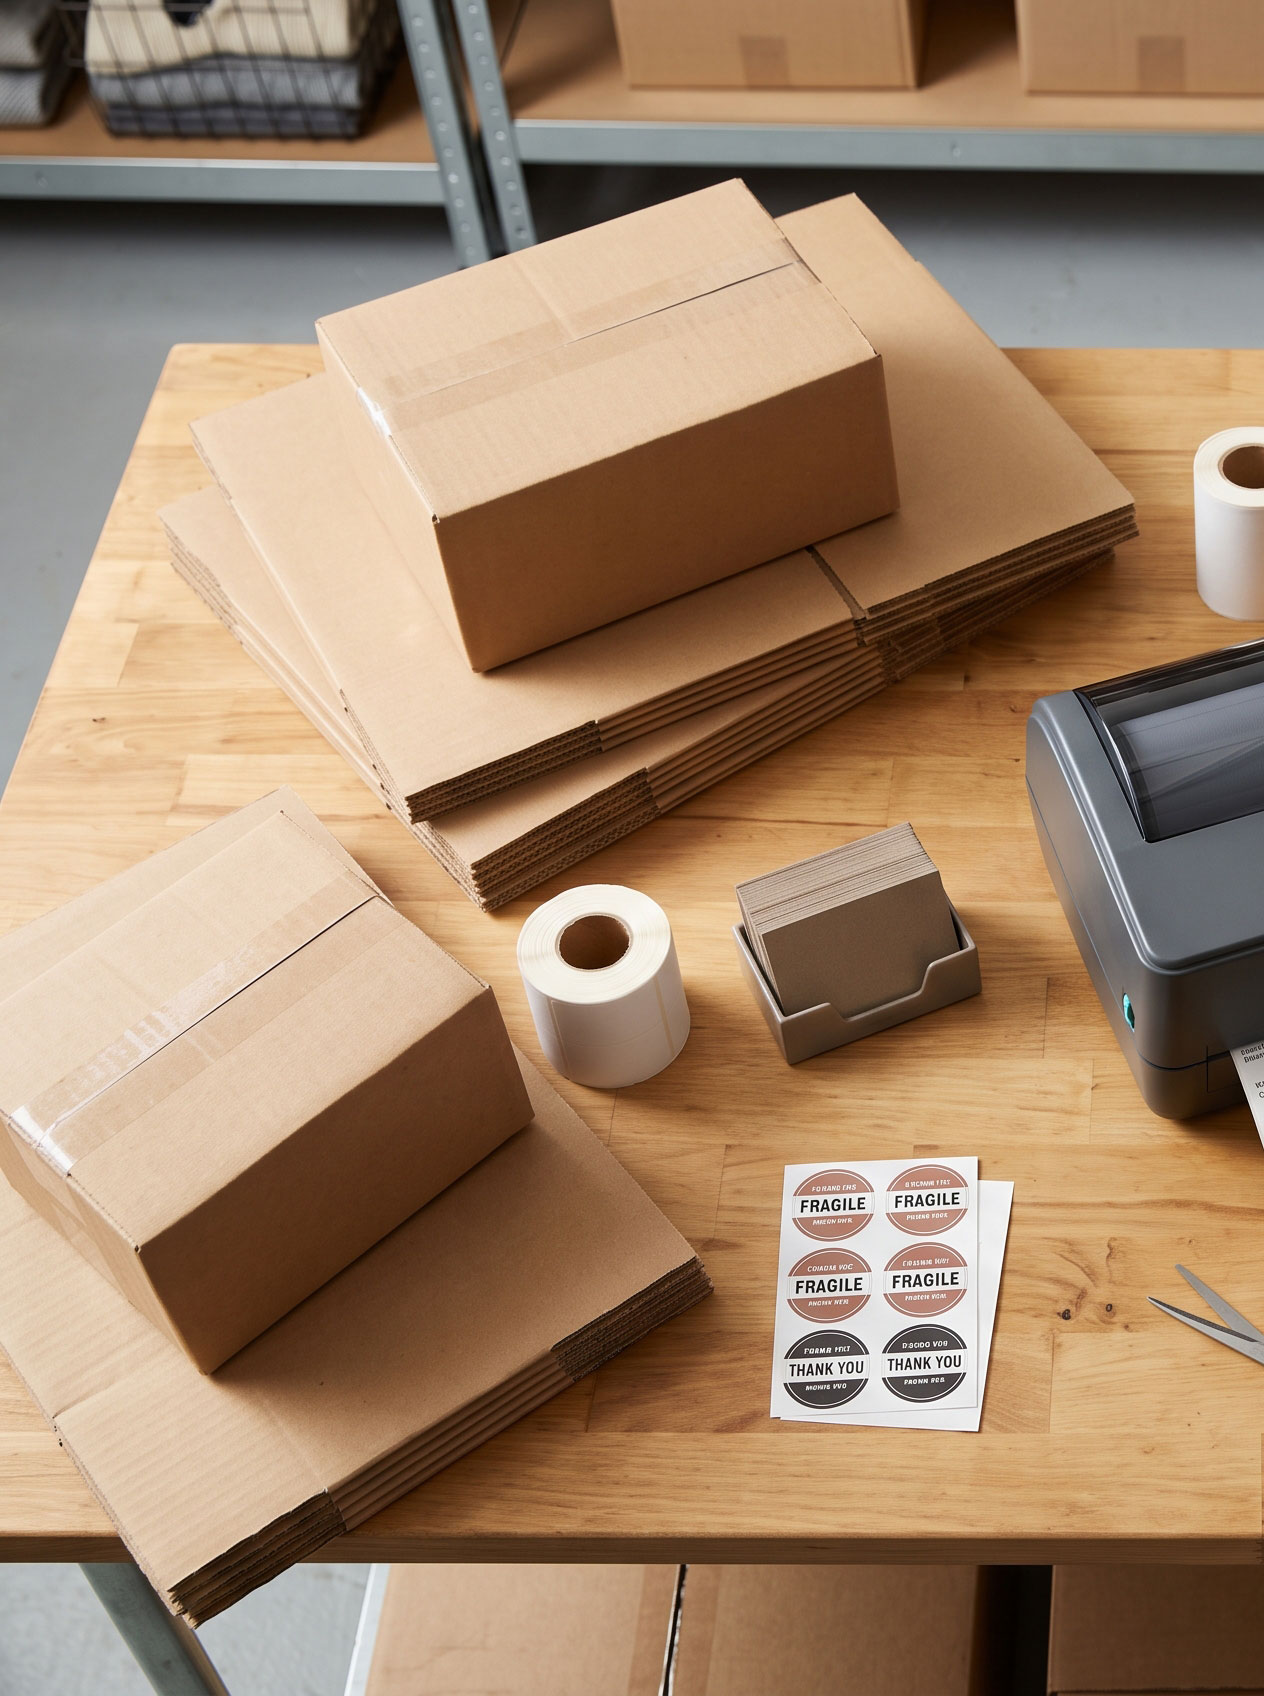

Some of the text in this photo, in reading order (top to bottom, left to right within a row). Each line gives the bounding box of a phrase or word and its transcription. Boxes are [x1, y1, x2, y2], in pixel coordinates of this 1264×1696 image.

[800, 1197, 866, 1213] FRAGILE
[895, 1192, 960, 1209] FRAGILE
[795, 1277, 863, 1294] FRAGILE
[892, 1272, 960, 1289] FRAGILE
[789, 1360, 864, 1377] THANK YOU
[887, 1355, 962, 1371] THANK YOU
